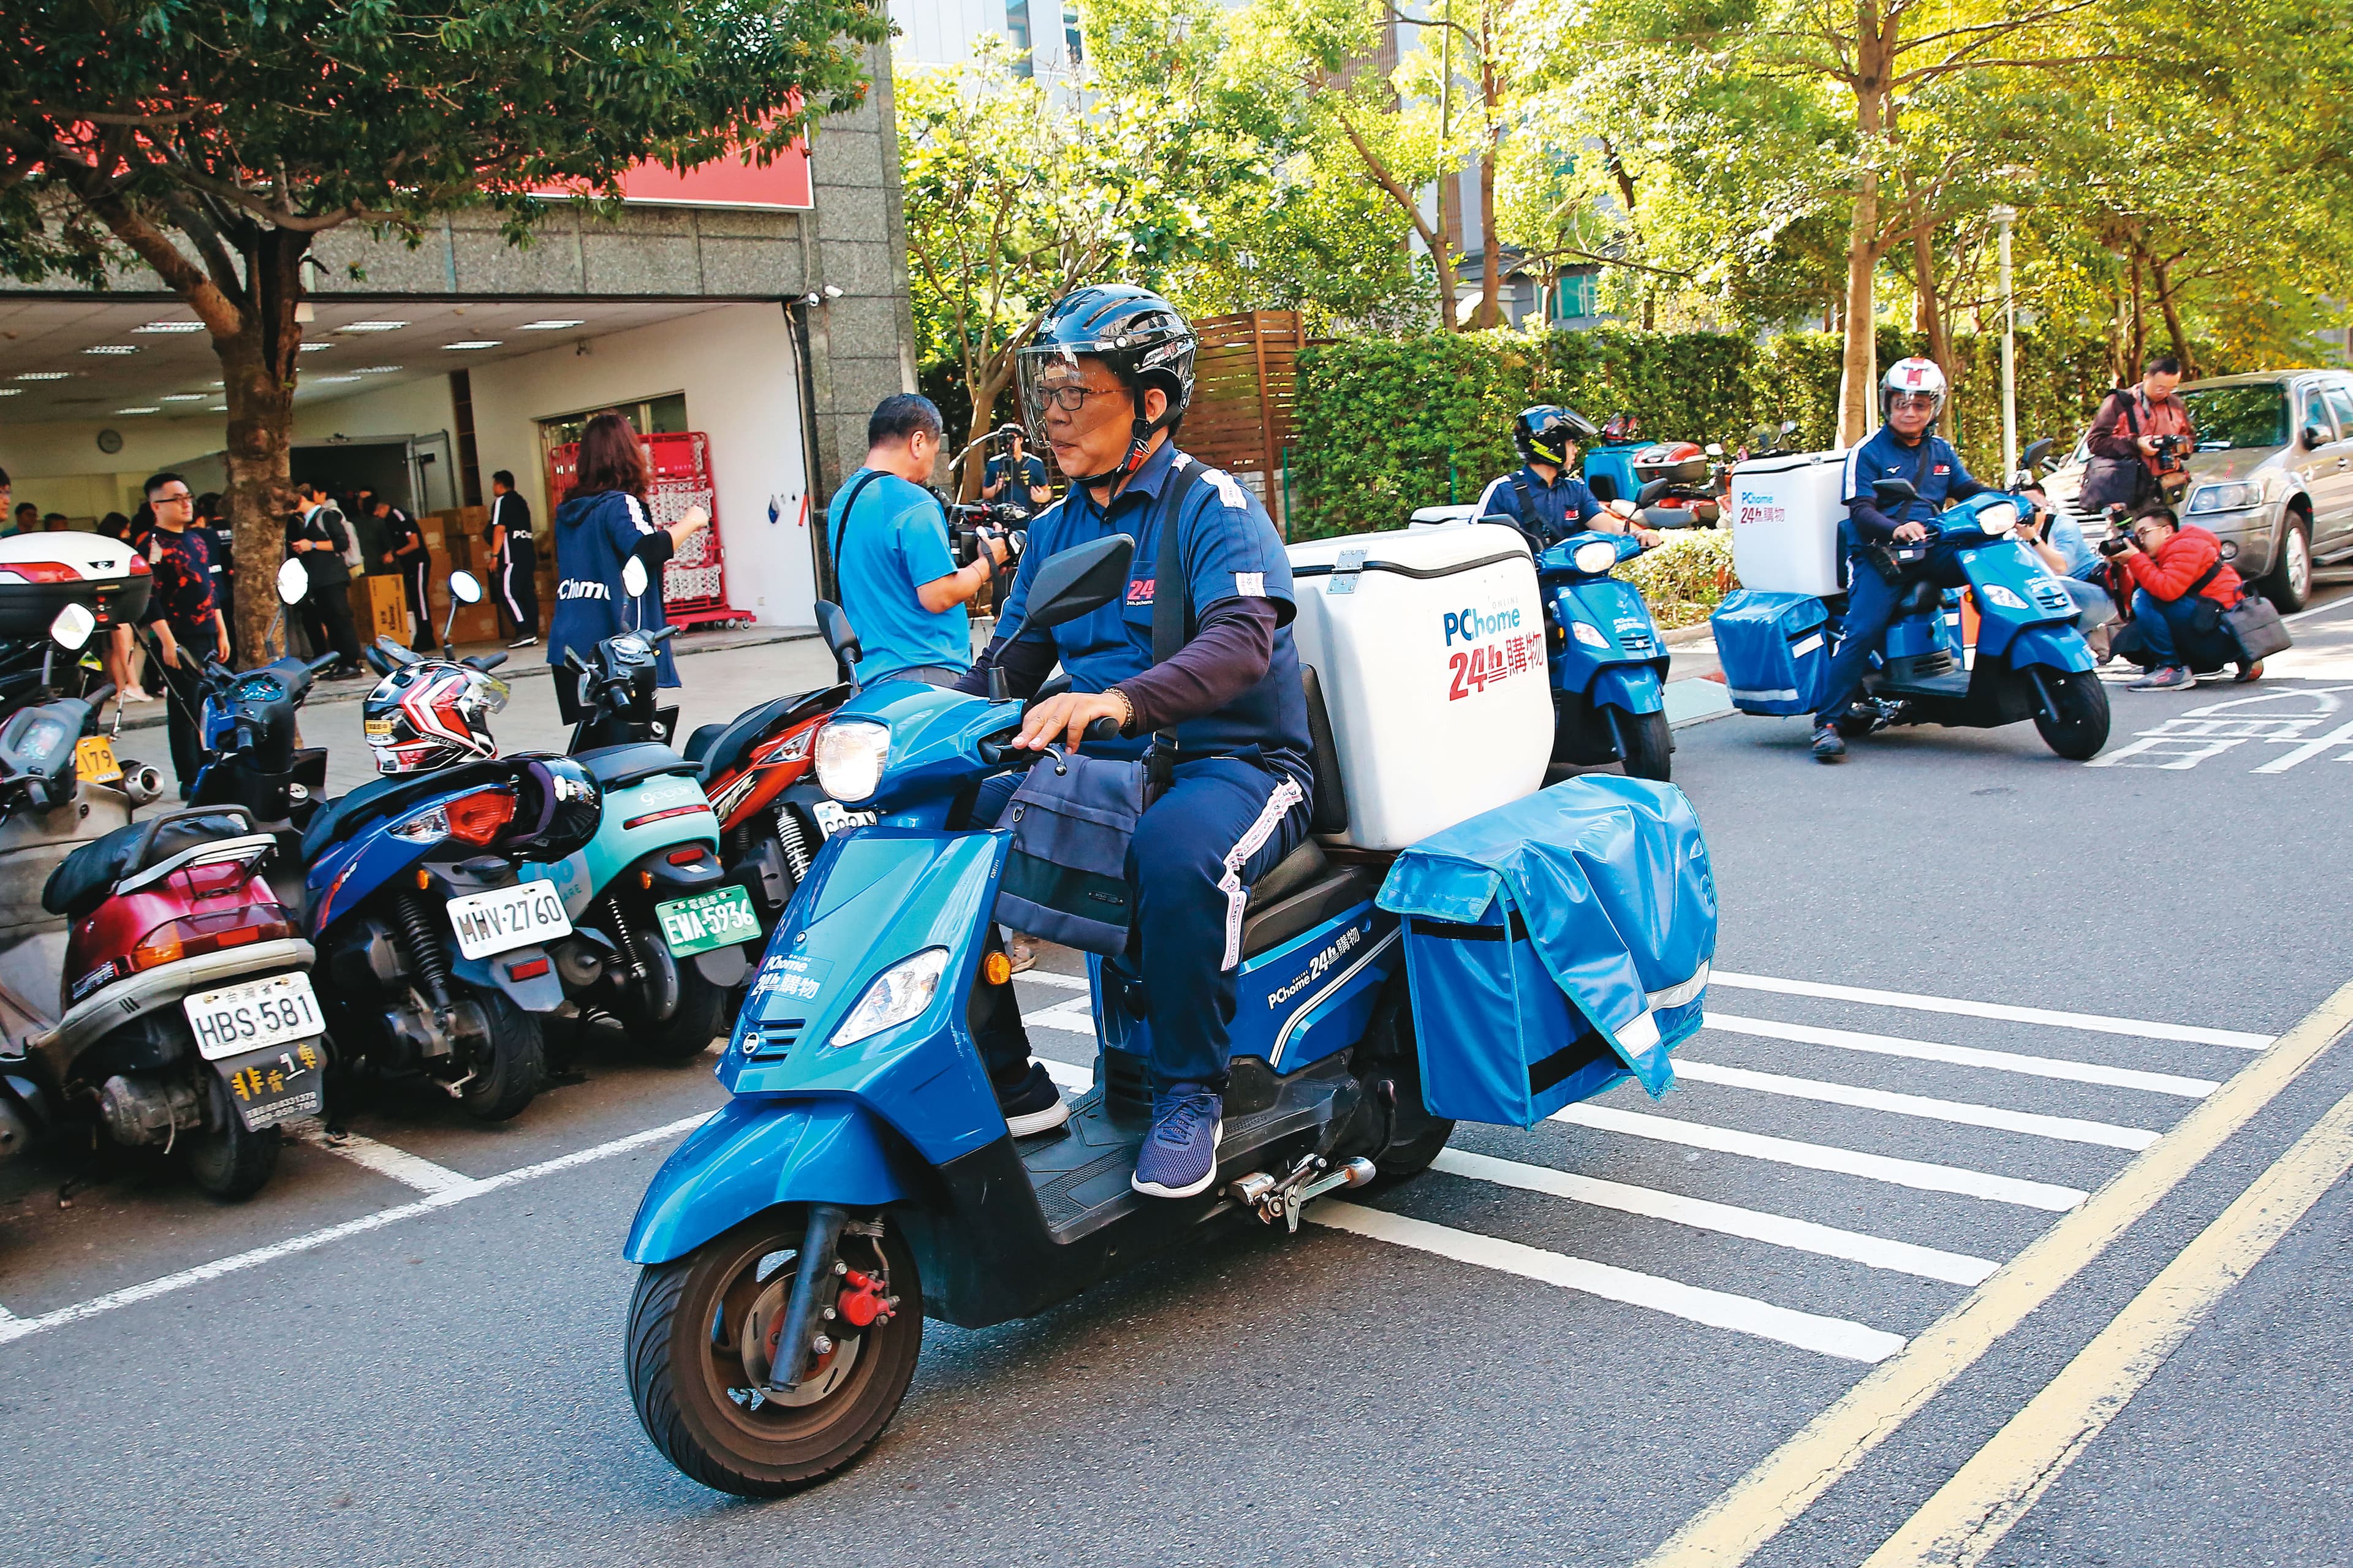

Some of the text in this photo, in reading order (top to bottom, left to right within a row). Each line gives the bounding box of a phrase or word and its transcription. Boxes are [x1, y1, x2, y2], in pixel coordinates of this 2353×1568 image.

[1444, 608, 1521, 646] PChome
[687, 895, 719, 910] 電動車
[763, 955, 808, 973] PChome
[789, 954, 812, 963] ONLINE
[1267, 976, 1311, 1010] PChome
